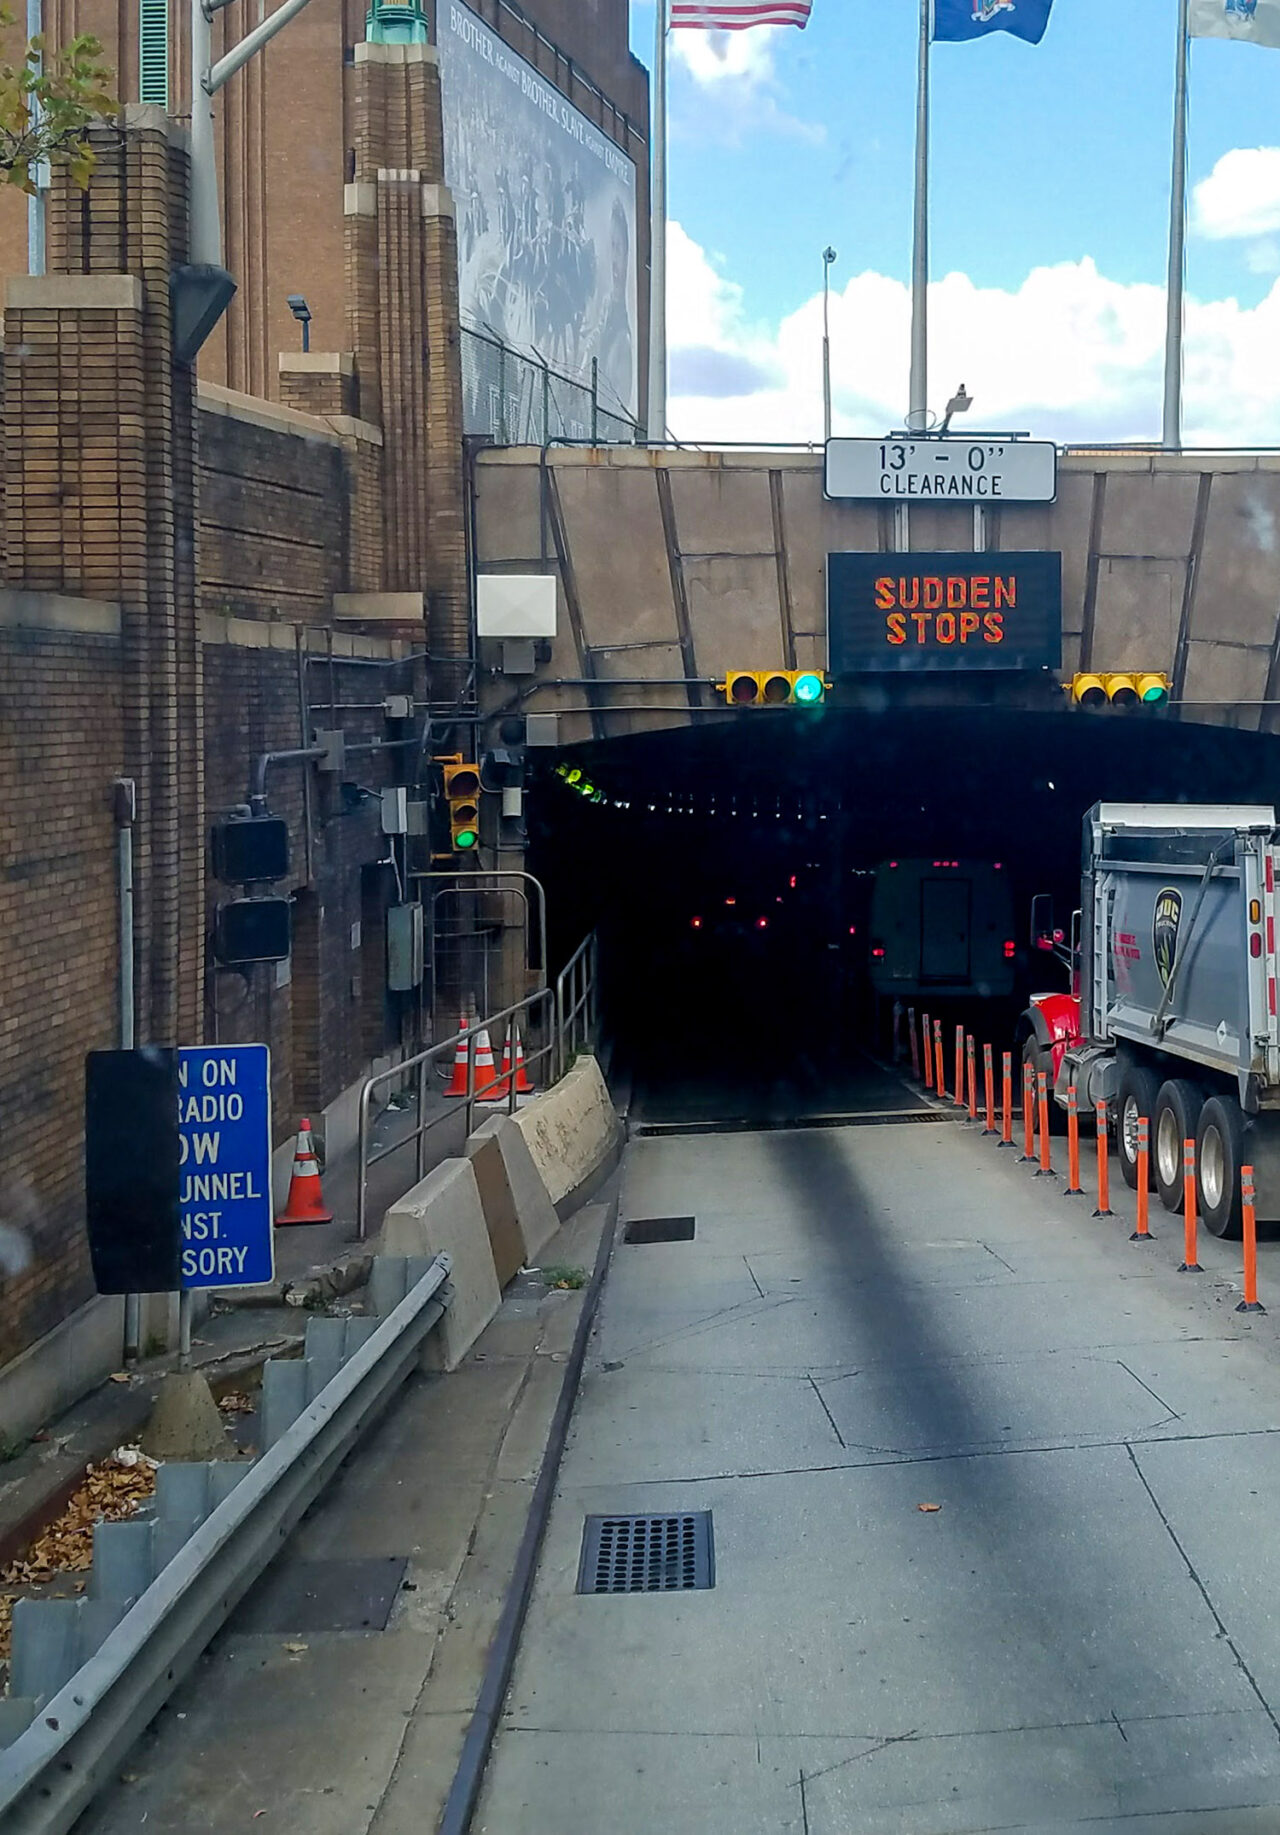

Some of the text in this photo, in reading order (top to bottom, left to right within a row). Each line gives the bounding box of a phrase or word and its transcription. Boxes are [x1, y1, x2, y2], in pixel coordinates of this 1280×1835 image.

[450, 6, 495, 66] BROTHER
[495, 54, 521, 85] AGAINST
[561, 107, 584, 146] SLAVE
[880, 473, 1003, 496] CLEARANCE
[874, 576, 1016, 610] SUDDEN
[885, 611, 1004, 645] STOPS
[202, 1059, 236, 1087] ON
[179, 1171, 262, 1202] UNNEL
[181, 1211, 228, 1240] NST.
[181, 1246, 249, 1277] SORY
